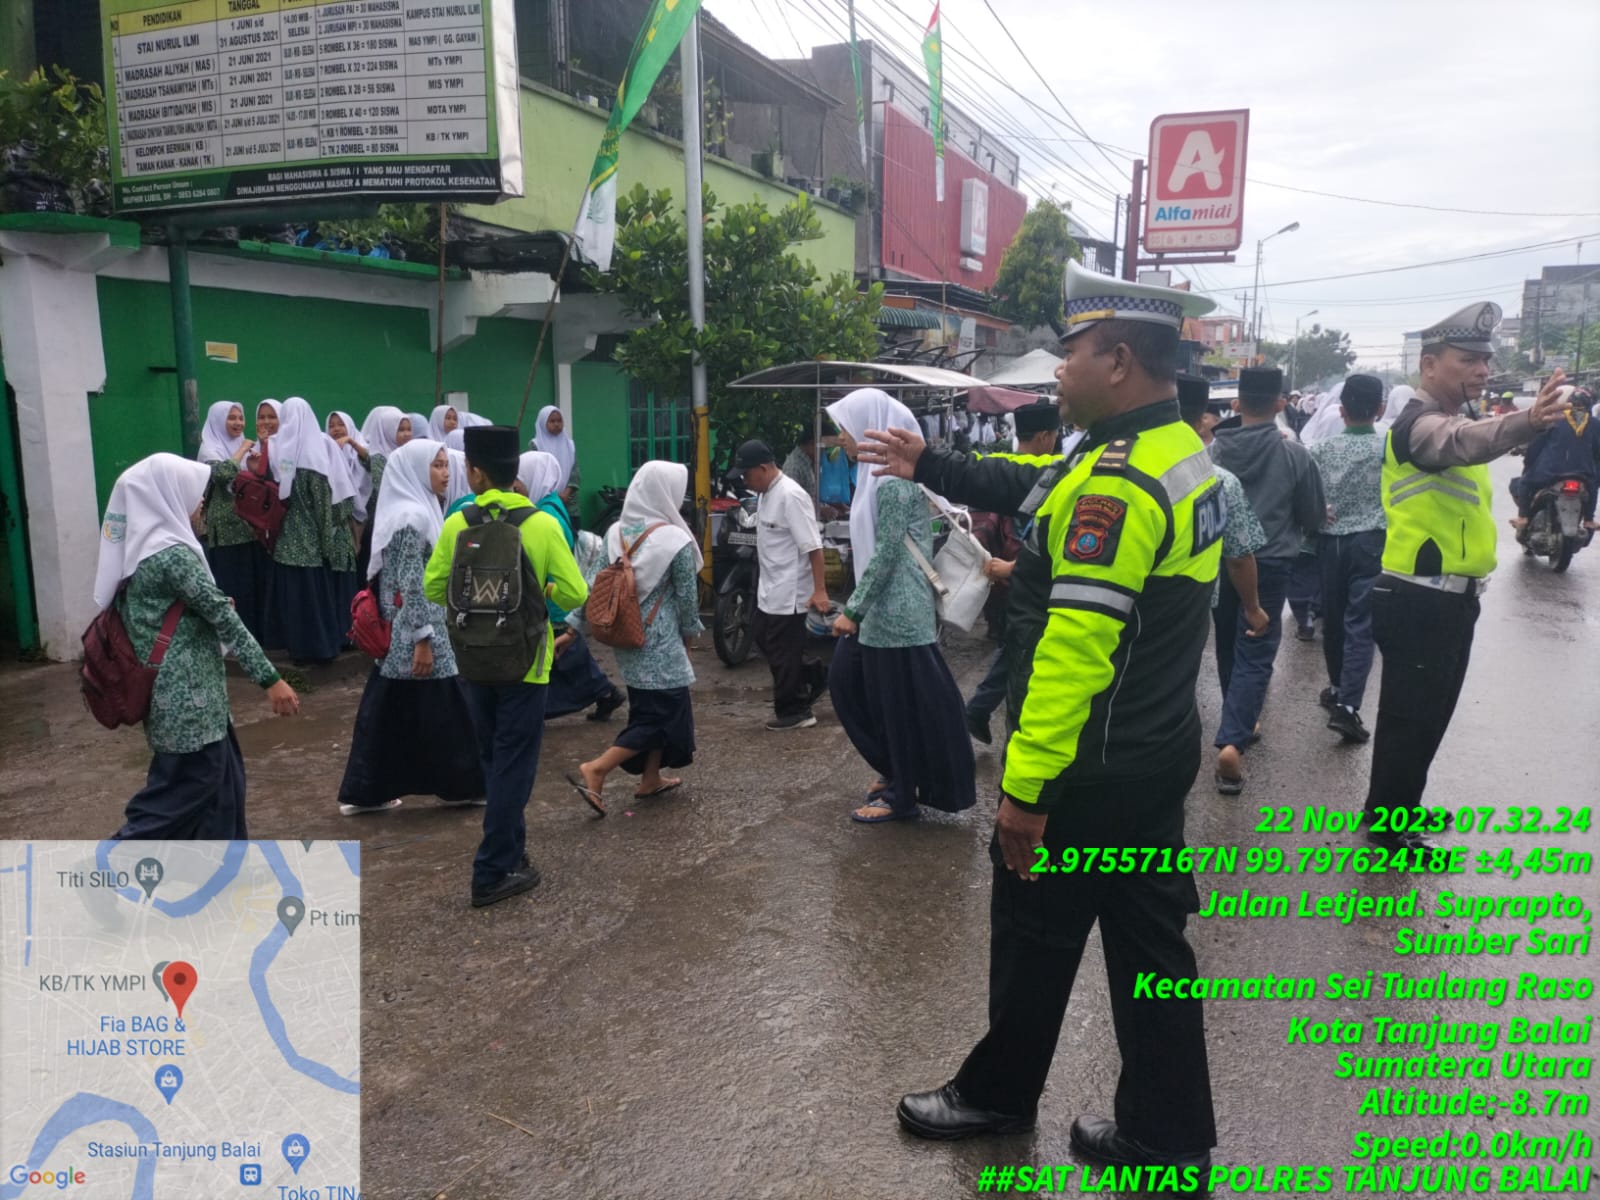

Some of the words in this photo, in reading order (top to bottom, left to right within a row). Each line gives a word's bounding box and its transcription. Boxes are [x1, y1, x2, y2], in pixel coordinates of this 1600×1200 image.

[228, 0, 260, 12] TANGGAL
[143, 9, 182, 26] PENDIDIKAN
[406, 8, 430, 20] KAMPUS
[432, 7, 445, 18] STAI
[446, 6, 466, 16] NURUL
[236, 19, 252, 30] JUNI
[288, 26, 310, 38] SELESAI
[137, 41, 154, 54] STAI
[156, 37, 182, 51] NURUL
[183, 34, 199, 47] ILMI
[219, 38, 228, 48] 31
[229, 33, 260, 46] AGUSTUS
[262, 30, 278, 42] 2021
[378, 38, 398, 49] SISWA
[423, 35, 437, 46] YMPI
[456, 32, 476, 43] GAYAM
[228, 56, 236, 67] 21
[238, 53, 254, 65] JUNI
[255, 51, 272, 63] 2021
[379, 60, 398, 71] SISWA
[428, 56, 442, 66] MTs
[444, 55, 462, 65] YMPI
[125, 66, 162, 81] MADRASAH
[164, 62, 189, 77] ALIYAH
[229, 75, 237, 86] 21
[239, 72, 255, 84] JUNI
[256, 71, 272, 82] 2021
[428, 79, 442, 89] MIS
[444, 78, 464, 88] YMPI
[125, 87, 157, 100] MADRASAH
[158, 81, 196, 96] TSANAWIYAH
[376, 82, 395, 93] SISWA
[230, 98, 238, 109] 21
[240, 95, 256, 108] JUNI
[257, 94, 273, 105] 2021
[380, 106, 400, 116] SISWA
[448, 104, 466, 113] YMPI
[128, 109, 160, 122] MADRASAH
[340, 126, 364, 136] ROMBEL
[379, 125, 398, 135] SISWA
[425, 132, 435, 142] KB
[440, 132, 450, 140] TK
[452, 131, 469, 140] YMPI
[135, 146, 165, 158] KELOMPOK
[340, 144, 365, 153] ROMBEL
[380, 143, 399, 152] SISWA
[136, 161, 155, 172] TAMAN
[156, 159, 176, 170] KANAK
[178, 156, 198, 169] KANAK
[284, 169, 322, 180] MAHASISWA
[363, 166, 384, 175] YANG
[385, 165, 402, 174] MAU
[404, 164, 451, 174] MENDAFTAR
[276, 180, 325, 193] MENGGUNAKAN
[326, 178, 353, 188] MASKER
[362, 177, 403, 186] MEMATUHI
[405, 177, 446, 186] PROTOKOL
[448, 176, 496, 186] KESEHATAN
[1154, 204, 1232, 222] Alfamidi
